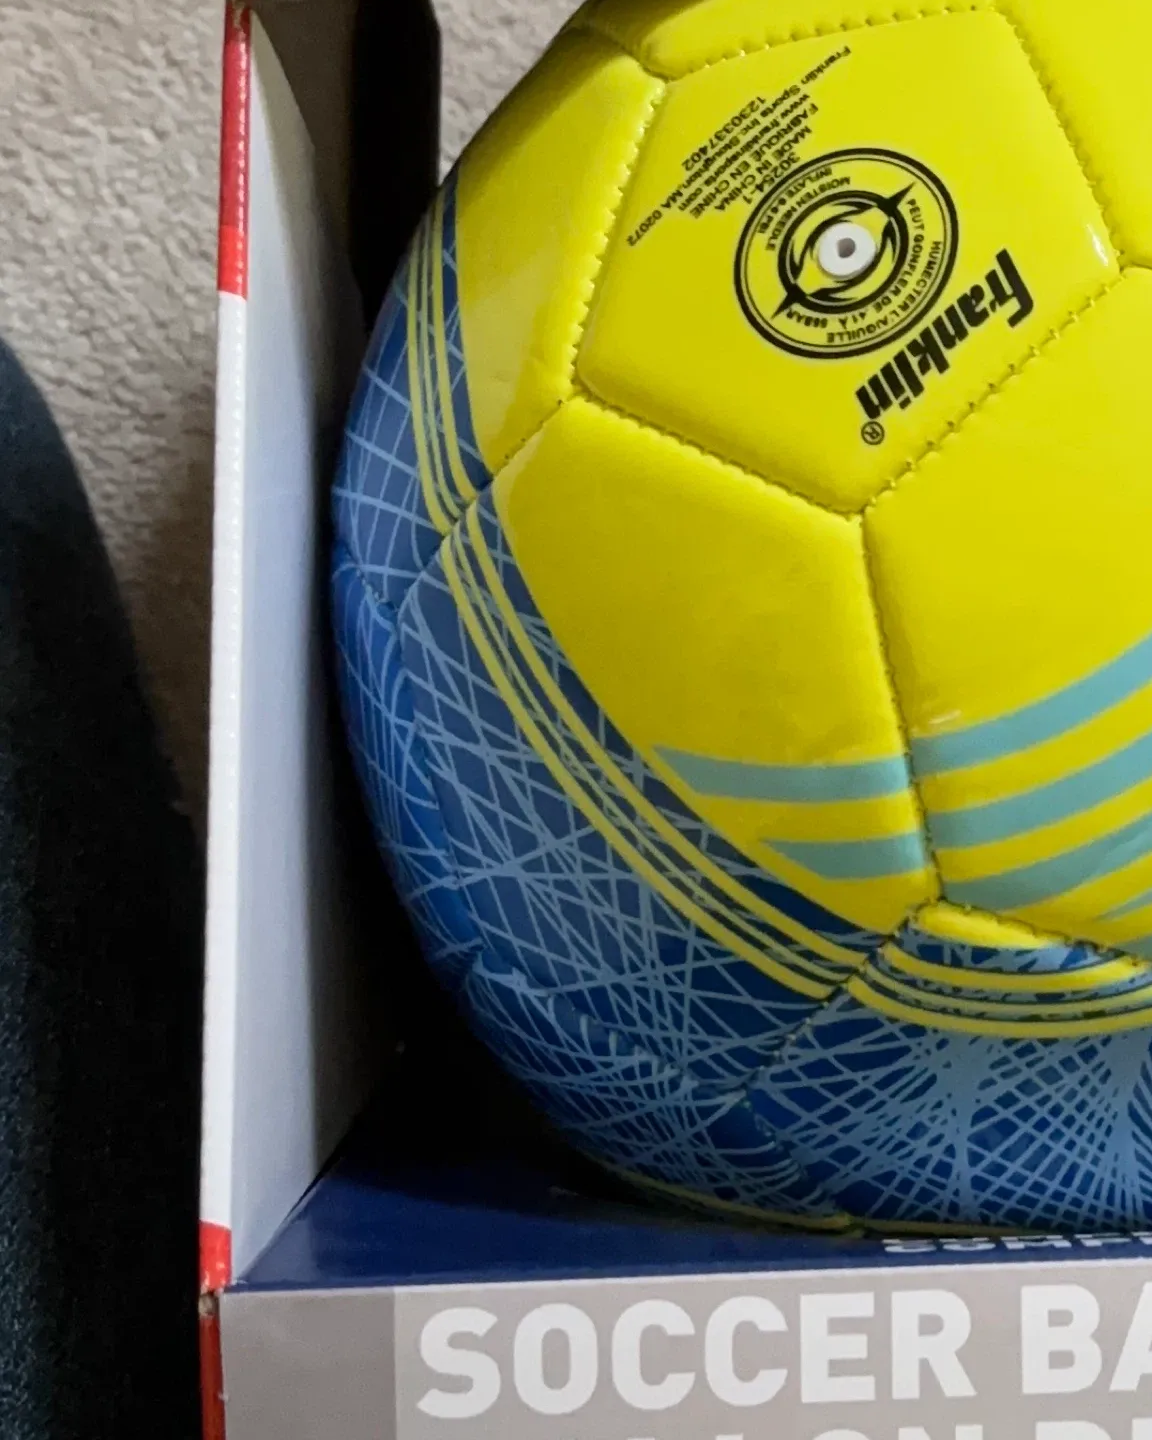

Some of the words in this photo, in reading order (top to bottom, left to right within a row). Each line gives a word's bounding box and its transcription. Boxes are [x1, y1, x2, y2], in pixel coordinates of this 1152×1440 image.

[801, 45, 852, 86] Franklin
[760, 84, 802, 120] Sports
[681, 96, 767, 172] 1230337402
[771, 126, 813, 164] MADE
[728, 159, 752, 181] EN
[741, 151, 801, 205] 30254-1
[754, 159, 775, 177] IN
[784, 164, 833, 199] INFLATE
[689, 179, 730, 220] CHINE
[713, 173, 757, 212] CHINA
[796, 176, 851, 209] MOISTEN
[626, 209, 663, 247] 02072
[763, 205, 799, 252] NEEDLE
[905, 198, 925, 231] PEUT
[887, 233, 924, 298] GONFLER
[896, 240, 943, 313] HUMECTER
[871, 293, 893, 314] DE
[416, 1287, 978, 1420] SOCCER
